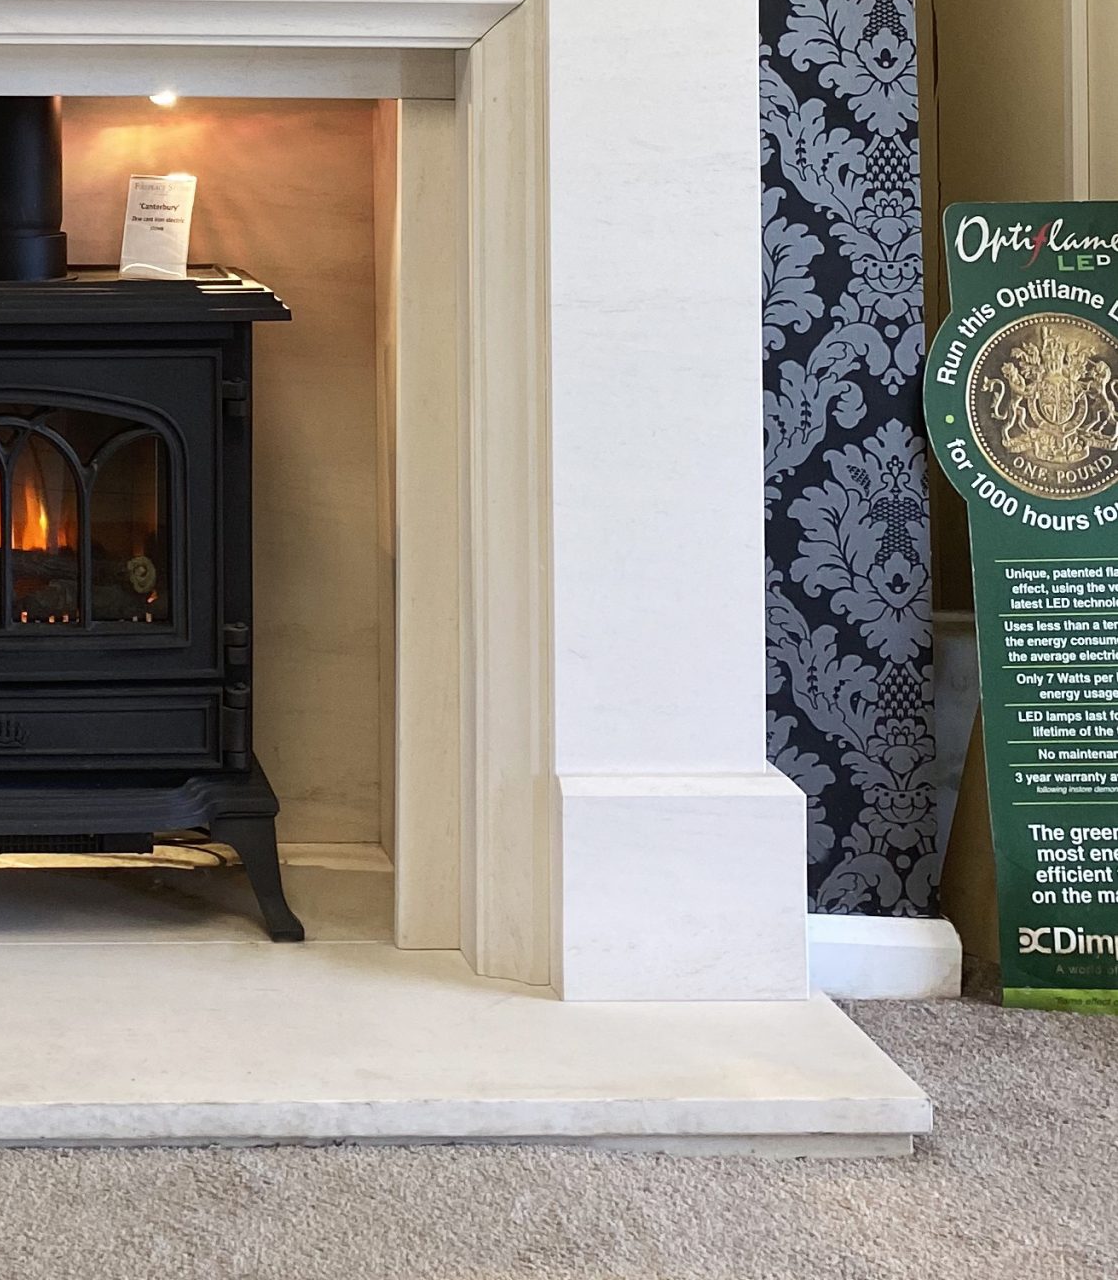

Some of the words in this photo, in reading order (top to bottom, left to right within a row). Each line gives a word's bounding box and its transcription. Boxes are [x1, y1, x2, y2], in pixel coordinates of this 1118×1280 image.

[1057, 254, 1111, 271] LED
[937, 345, 967, 385] Run
[959, 302, 996, 341] this
[996, 278, 1104, 309] Optiflame
[1013, 456, 1048, 482] ONE
[1056, 455, 1113, 484] POUND
[947, 438, 973, 470] for
[970, 472, 1018, 516] 1000
[1022, 504, 1090, 531] hours
[1005, 568, 1050, 581] Unique,
[1053, 567, 1103, 581] patented
[1012, 583, 1049, 595] effect,
[1052, 582, 1084, 595] using
[1087, 582, 1105, 593] the
[1010, 598, 1043, 609] latest
[1046, 597, 1070, 609] LED
[1004, 621, 1034, 632] Uses
[1036, 620, 1061, 631] less
[1064, 619, 1090, 631] than
[1092, 622, 1100, 630] a
[1005, 636, 1024, 647] the
[1027, 637, 1067, 649] energy
[1008, 651, 1027, 662] the
[1030, 652, 1076, 664] average
[1016, 673, 1044, 687] Only
[1046, 673, 1053, 684] 7
[1057, 672, 1091, 684] Watts
[1094, 674, 1114, 686] per
[1039, 689, 1080, 701] energy
[1084, 689, 1118, 701] usage
[1018, 711, 1043, 722] LED
[1046, 710, 1082, 724] lamps
[1085, 710, 1107, 721] last
[1033, 726, 1076, 737] lifetime
[1079, 725, 1092, 736] of
[1094, 725, 1114, 736] the
[1038, 748, 1055, 760] No
[1015, 772, 1023, 783] 3
[1026, 773, 1051, 785] year
[1054, 772, 1107, 785] warranty
[1036, 786, 1068, 794] following
[1028, 824, 1064, 841] The
[1037, 846, 1085, 862] most
[1036, 866, 1113, 883] efficient
[1032, 890, 1056, 904] on
[1062, 888, 1092, 903] the
[1053, 927, 1118, 961] Dim
